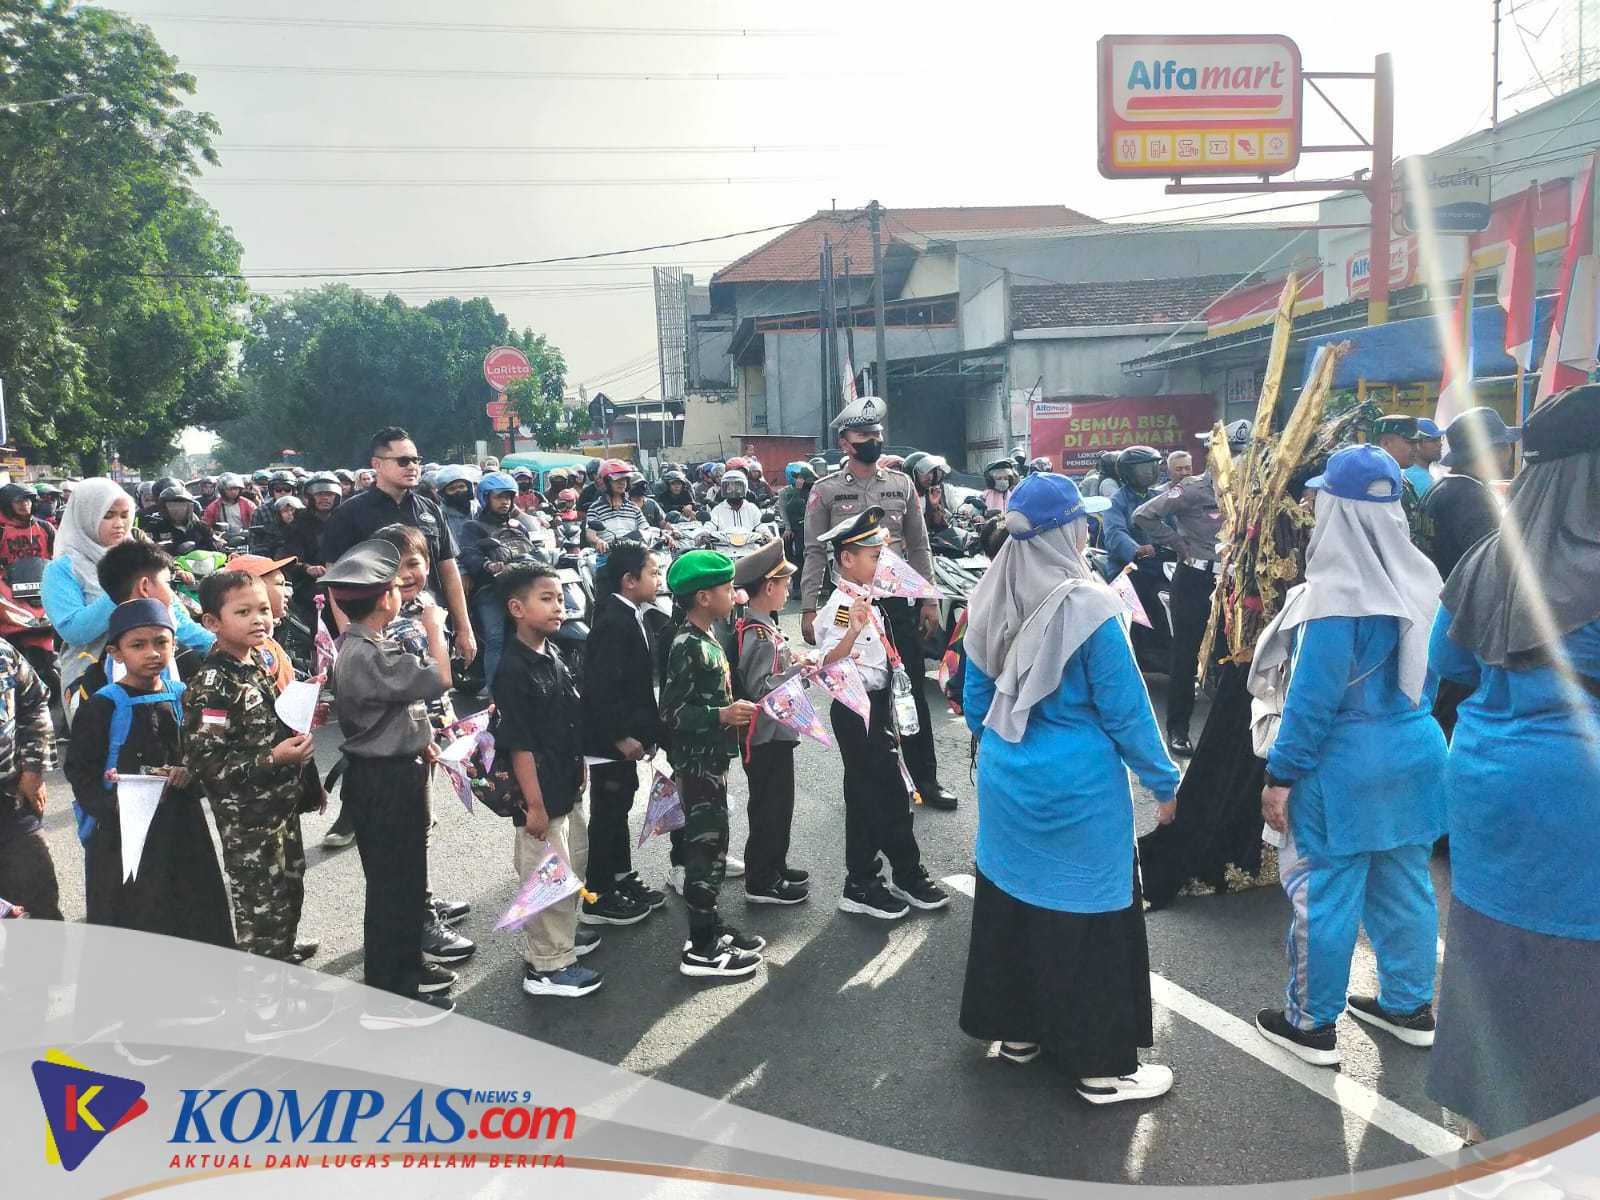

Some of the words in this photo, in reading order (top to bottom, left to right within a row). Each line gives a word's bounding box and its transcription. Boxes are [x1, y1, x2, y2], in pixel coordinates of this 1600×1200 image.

[1126, 60, 1286, 90] Alfamart
[1070, 417, 1131, 432] SEMUA
[1138, 415, 1178, 428] BISA
[1065, 432, 1083, 447] DI
[1089, 429, 1184, 446] ALFAMART
